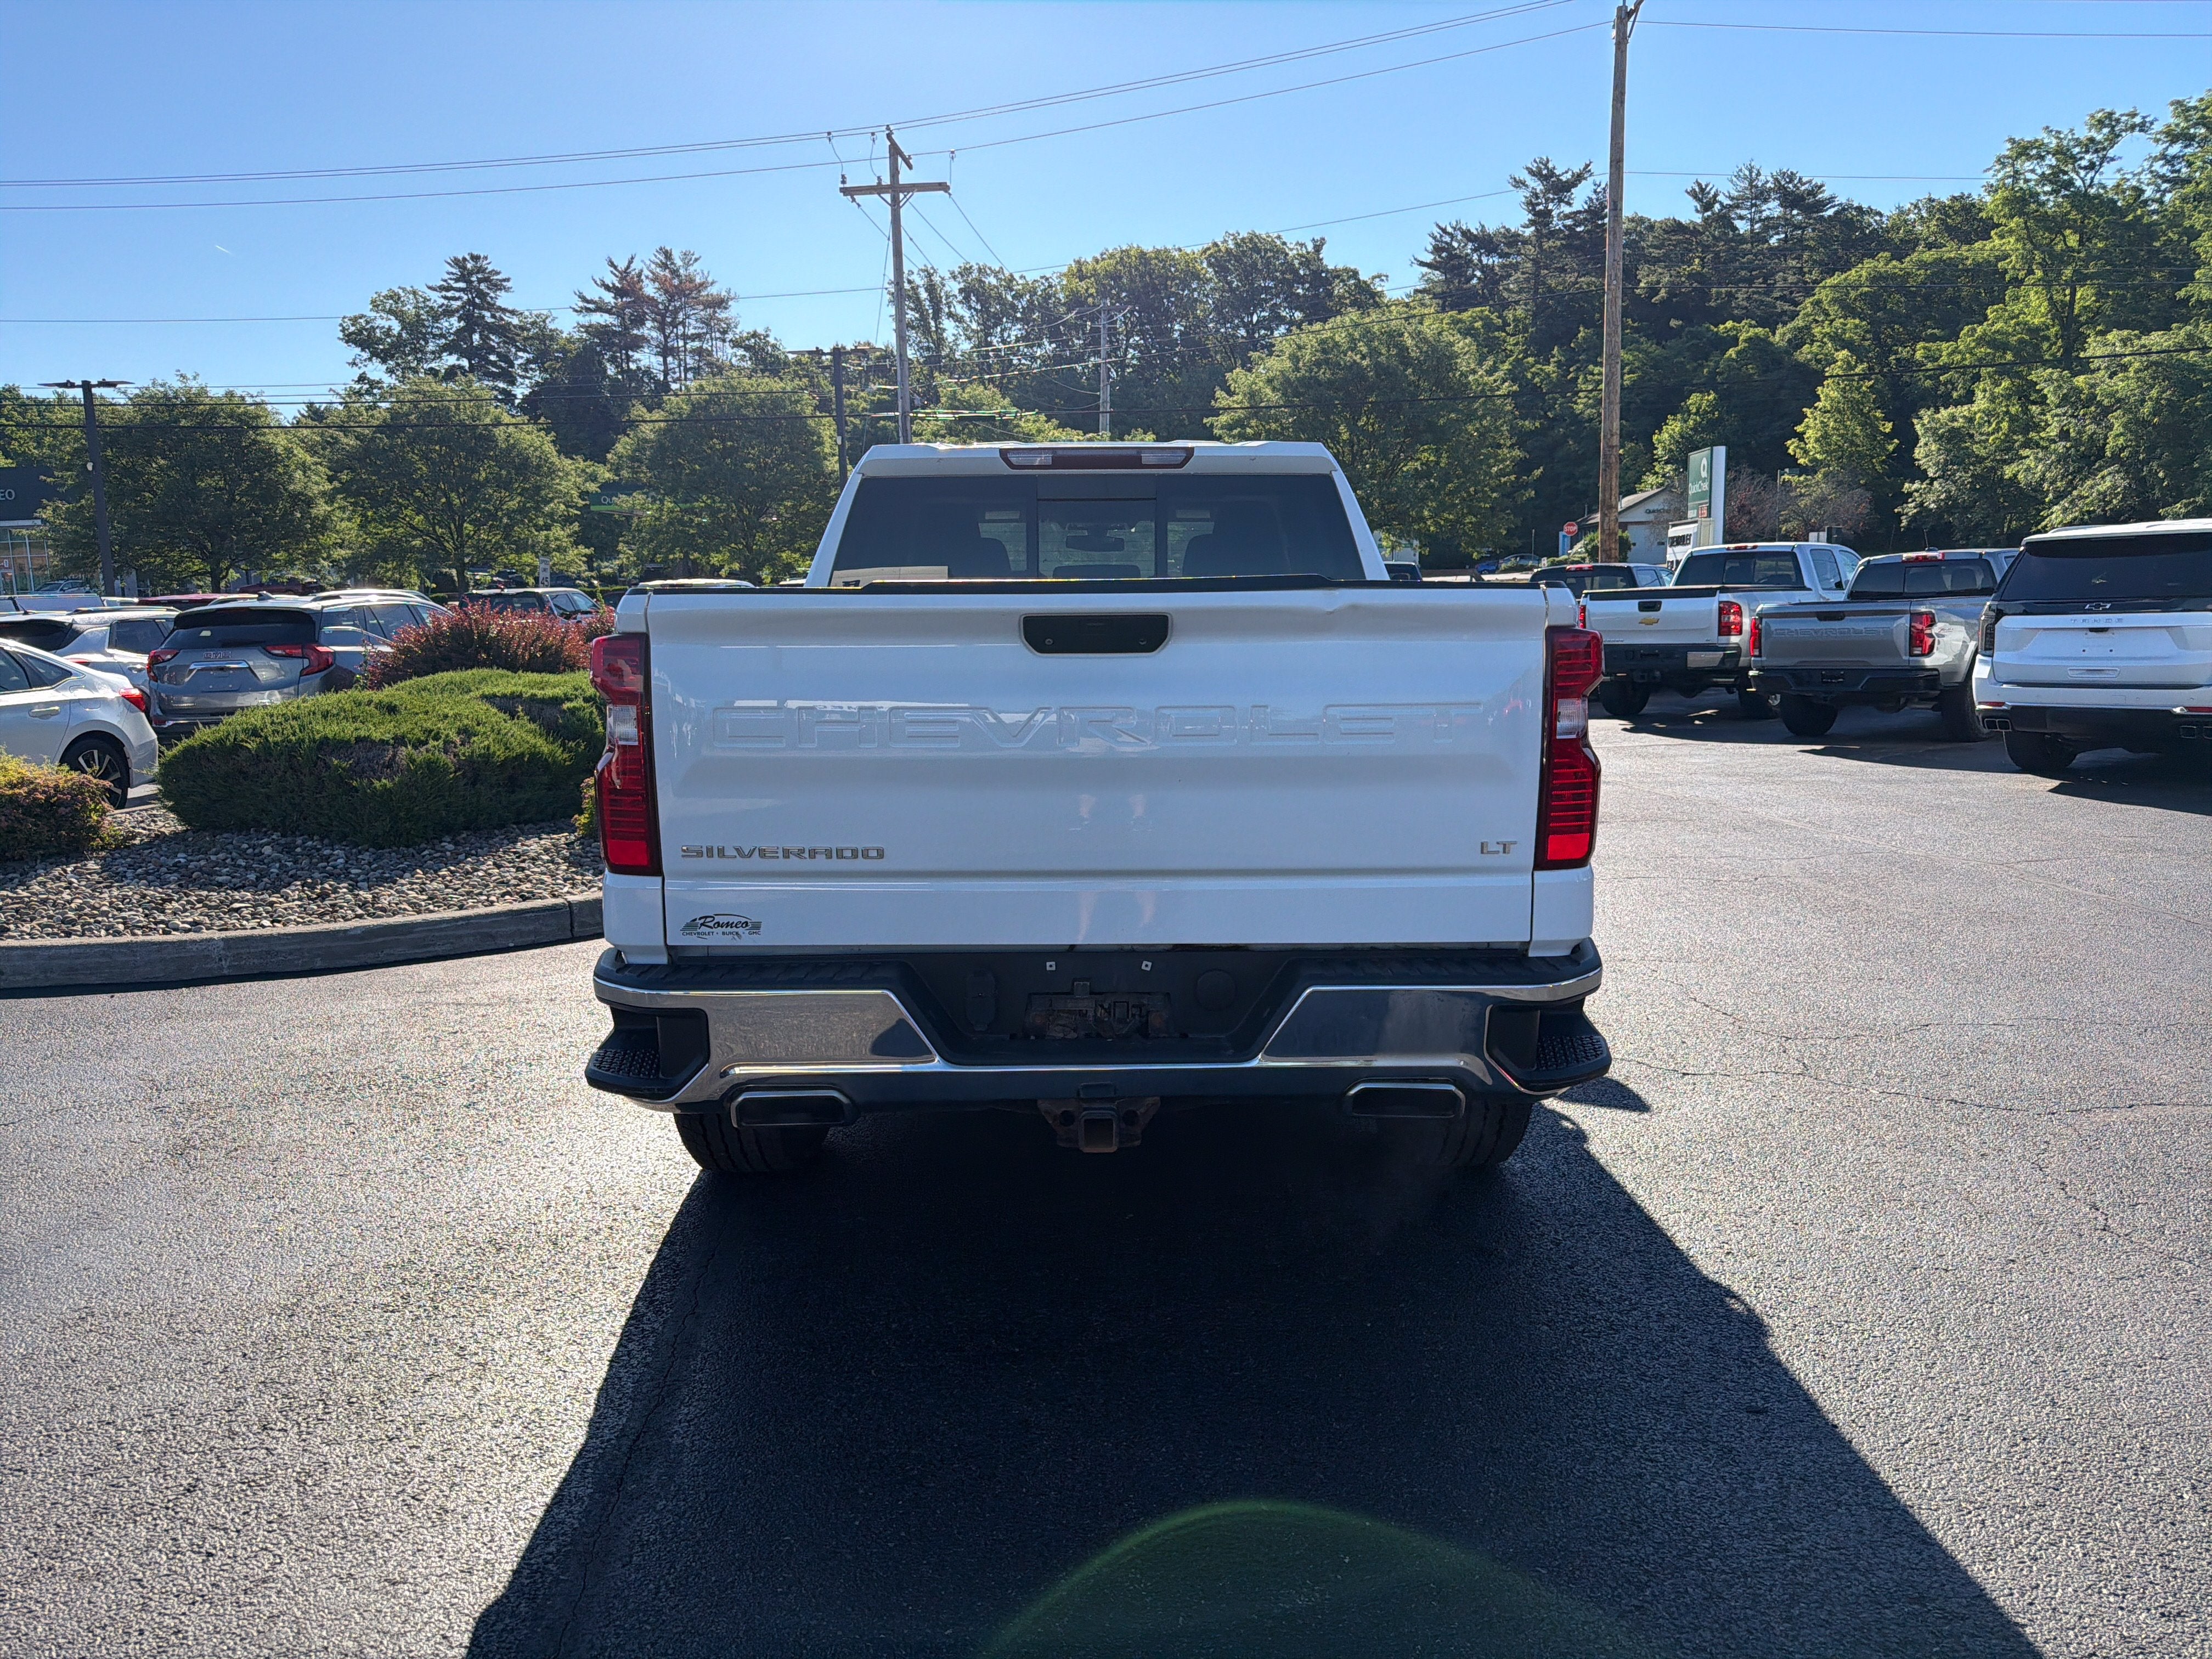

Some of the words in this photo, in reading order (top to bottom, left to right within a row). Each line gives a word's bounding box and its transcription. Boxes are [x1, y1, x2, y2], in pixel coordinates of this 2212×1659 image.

[540, 577, 549, 587] 45
[1773, 627, 1890, 637] CHEVROLET
[713, 703, 1482, 748] CHEVROLET
[681, 845, 885, 860] SILVERADO
[1481, 840, 1518, 854] LT
[698, 915, 751, 930] Romeo
